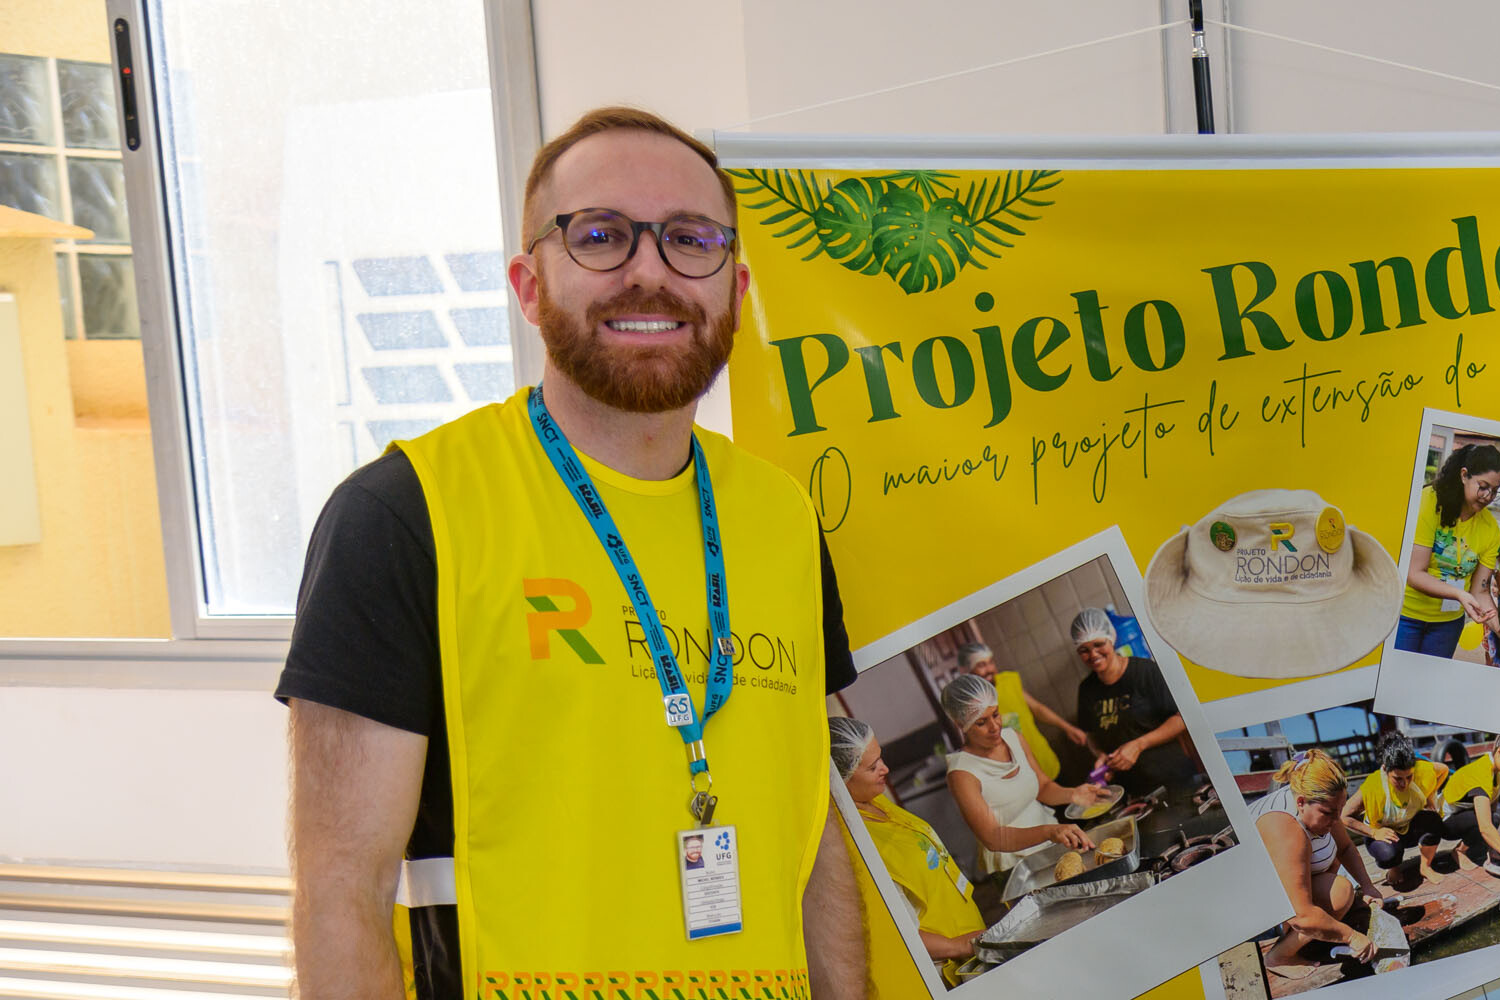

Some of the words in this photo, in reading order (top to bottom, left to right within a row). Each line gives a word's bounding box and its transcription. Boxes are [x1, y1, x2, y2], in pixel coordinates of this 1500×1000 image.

[769, 290, 1187, 438] Projeto
[537, 413, 559, 443] SNCT
[809, 446, 852, 533] O
[883, 448, 1010, 496] maior
[1030, 392, 1187, 505] projeto
[1197, 380, 1240, 456] de
[1261, 362, 1426, 447] extensão
[1444, 333, 1488, 384] do
[578, 483, 605, 519] BRASIL
[702, 488, 713, 517] SNCT
[1236, 553, 1330, 577] RONDON
[627, 573, 649, 606] SNCT
[712, 572, 721, 608] BRASIL
[622, 605, 666, 621] PRTO
[632, 665, 657, 680] Liçã
[751, 676, 797, 696] cidadania
[659, 655, 681, 693] BRASIL
[714, 653, 729, 684] SNC
[671, 714, 690, 722] UFG
[716, 852, 732, 861] UFG
